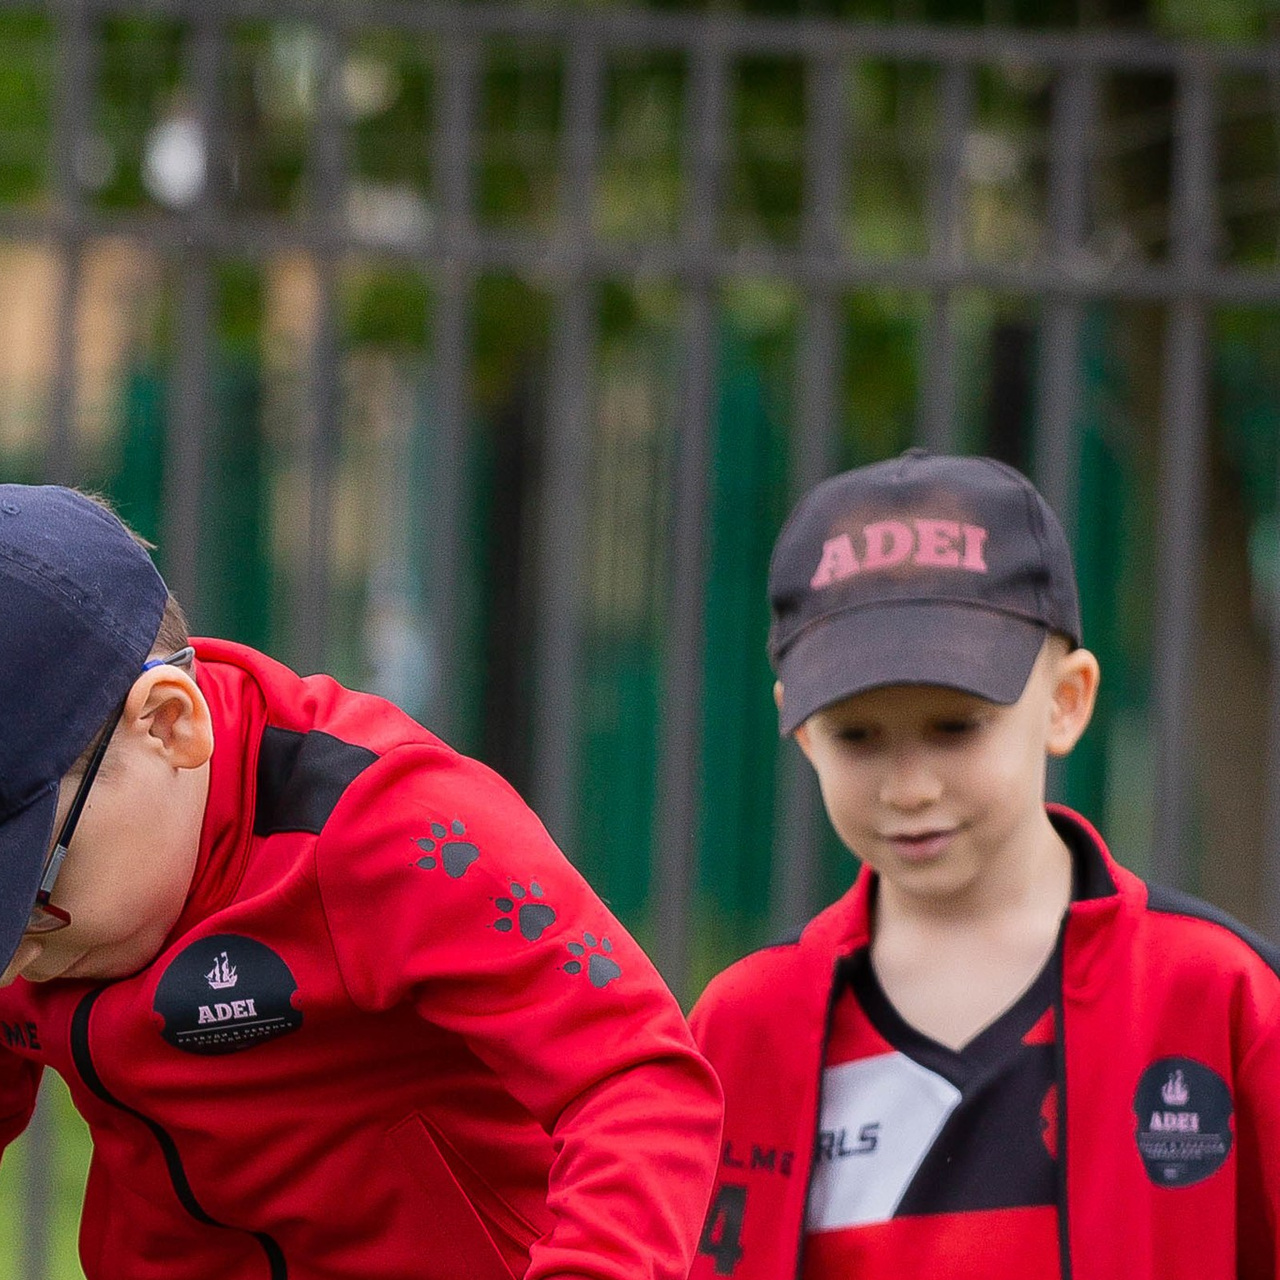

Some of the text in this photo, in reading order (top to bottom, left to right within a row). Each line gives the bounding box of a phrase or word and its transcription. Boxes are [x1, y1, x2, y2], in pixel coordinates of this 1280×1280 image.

[810, 518, 989, 591] ADEI
[197, 998, 258, 1025] ADEI
[1149, 1111, 1200, 1132] ADEI
[723, 1140, 794, 1177] LME
